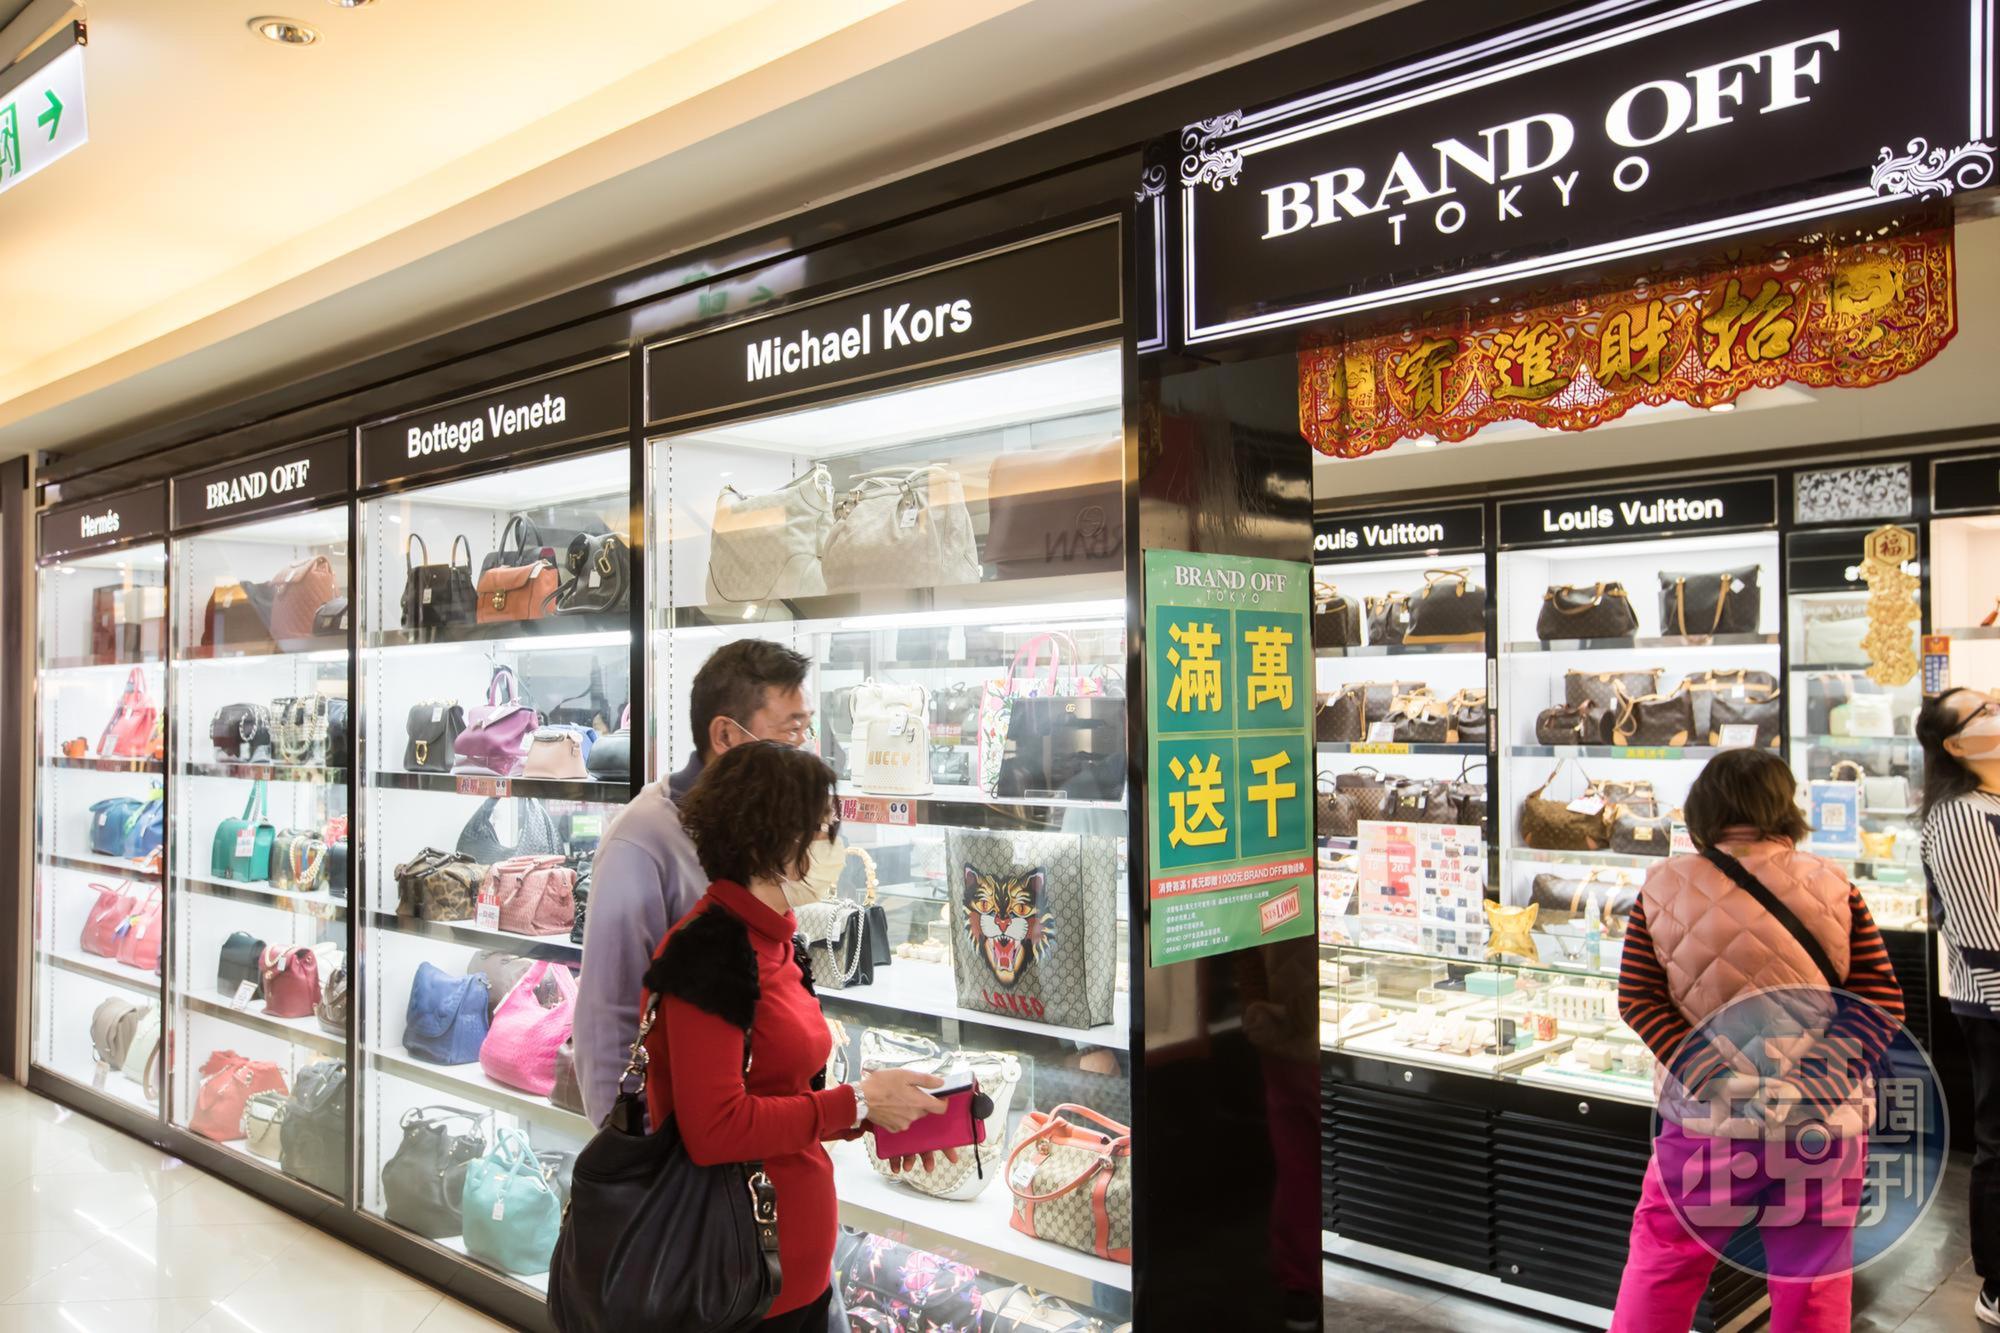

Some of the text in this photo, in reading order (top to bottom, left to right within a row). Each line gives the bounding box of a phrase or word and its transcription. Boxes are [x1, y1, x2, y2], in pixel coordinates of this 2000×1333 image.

[1261, 29, 1840, 240] BRAND OFF
[1388, 155, 1650, 245] TOKYO
[746, 298, 973, 383] Michael Kors
[407, 393, 567, 459] Bottega Veneta
[206, 459, 310, 510] BRAND OFF
[1543, 498, 1724, 532] Louis Vuitton
[1313, 523, 1444, 551] ouis Vuitton
[1879, 533, 1903, 557] 福
[1174, 565, 1288, 593] BRAND OFF
[1206, 589, 1261, 604] TOKYO
